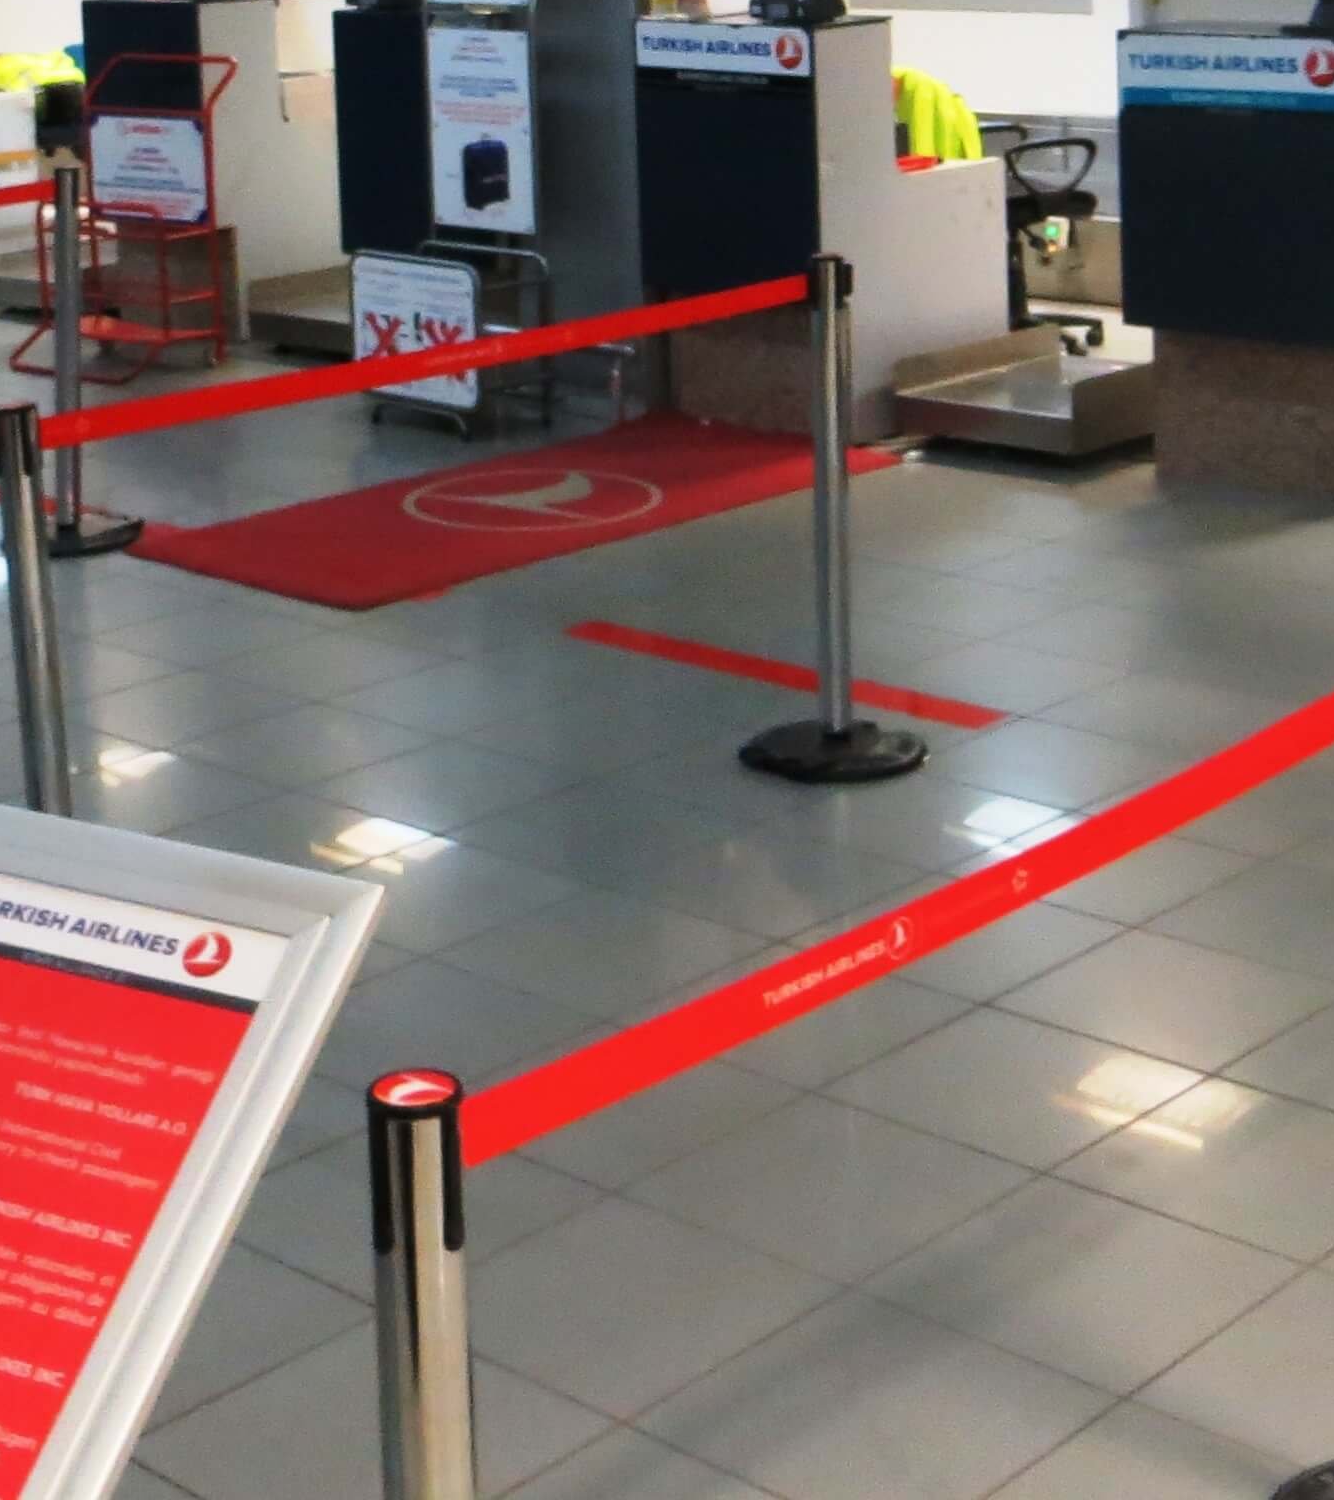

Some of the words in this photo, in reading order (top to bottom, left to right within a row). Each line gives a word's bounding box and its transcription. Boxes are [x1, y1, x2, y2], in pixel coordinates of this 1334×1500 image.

[642, 35, 703, 52] TURKISH
[705, 40, 771, 57] AIRLINES
[1128, 53, 1208, 71] TURKISH
[1212, 55, 1299, 74] AIRLINES
[68, 917, 181, 956] AIRLINES
